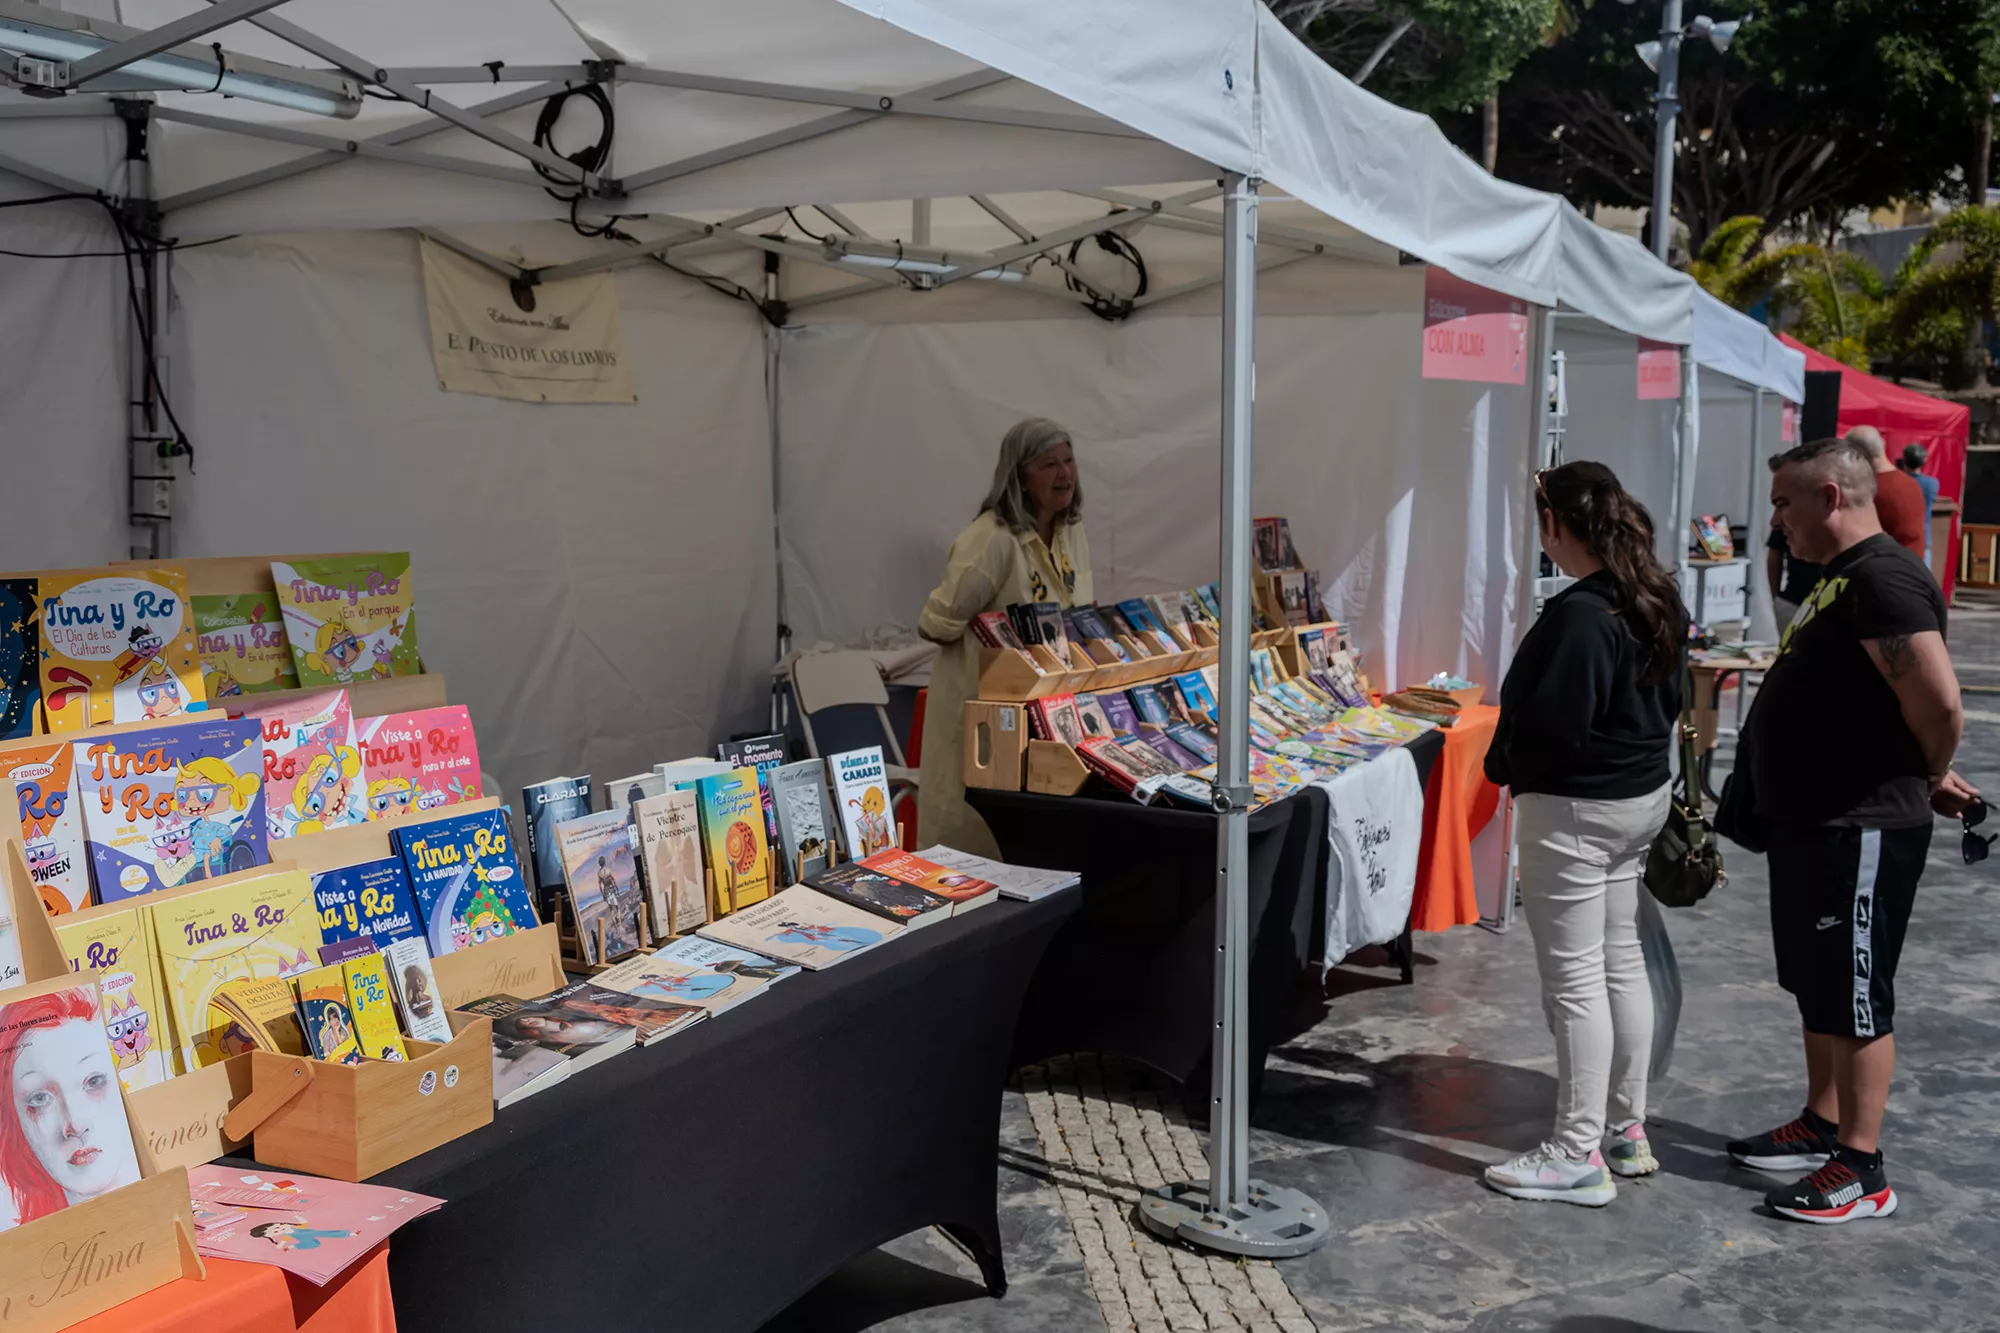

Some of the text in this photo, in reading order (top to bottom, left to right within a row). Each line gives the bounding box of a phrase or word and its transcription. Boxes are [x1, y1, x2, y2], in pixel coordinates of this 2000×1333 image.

[1428, 329, 1485, 357] CON ALMA
[520, 347, 538, 362] DE
[290, 571, 400, 606] Tina y Ro
[43, 590, 175, 631] Tina y Ro
[343, 604, 400, 620] En el parque
[203, 615, 247, 627] Coloreable
[52, 629, 63, 643] El
[87, 628, 99, 640] de
[102, 628, 117, 640] las
[233, 633, 246, 659] y
[251, 623, 283, 649] Ro
[70, 642, 111, 657] Culturas
[297, 725, 344, 748] AL COLE
[381, 729, 422, 744] Viste a
[409, 741, 421, 768] y
[427, 728, 460, 756] Ro
[731, 748, 783, 766] El momento
[87, 740, 174, 780] Tina
[264, 750, 296, 782] Ro
[422, 763, 439, 776] para
[456, 755, 471, 766] cole
[756, 760, 780, 772] CLICK
[840, 756, 868, 769] DÍMELO
[20, 765, 50, 778] EDICIÓN
[843, 765, 881, 781] CANARIO
[16, 781, 68, 822] Ro
[99, 782, 175, 822] y Ro
[537, 785, 588, 804] CLARA 13
[528, 825, 536, 852] CLARA
[646, 832, 656, 843] de
[412, 838, 461, 870] Tina
[464, 843, 476, 865] y
[474, 828, 506, 857] Ro
[875, 855, 914, 871] TEMPLO
[423, 865, 464, 882] LA NAVIDAD
[898, 868, 931, 882] LUZ
[317, 890, 356, 908] Viste a
[343, 902, 359, 932] y
[360, 888, 394, 918] Ro
[184, 904, 285, 947] Tina & Ro
[359, 923, 372, 936] de
[87, 942, 118, 969] Ro
[108, 975, 134, 990] EDICIÓN
[236, 980, 283, 998] VERDADES
[352, 972, 380, 990] Tina
[246, 989, 287, 1005] OCULTAS
[356, 986, 384, 1012] y Ro
[8, 1022, 19, 1031] las
[19, 1017, 38, 1029] flores
[38, 1013, 58, 1025] azules
[1828, 1181, 1864, 1208] PUMA
[28, 1230, 145, 1308] Alma
